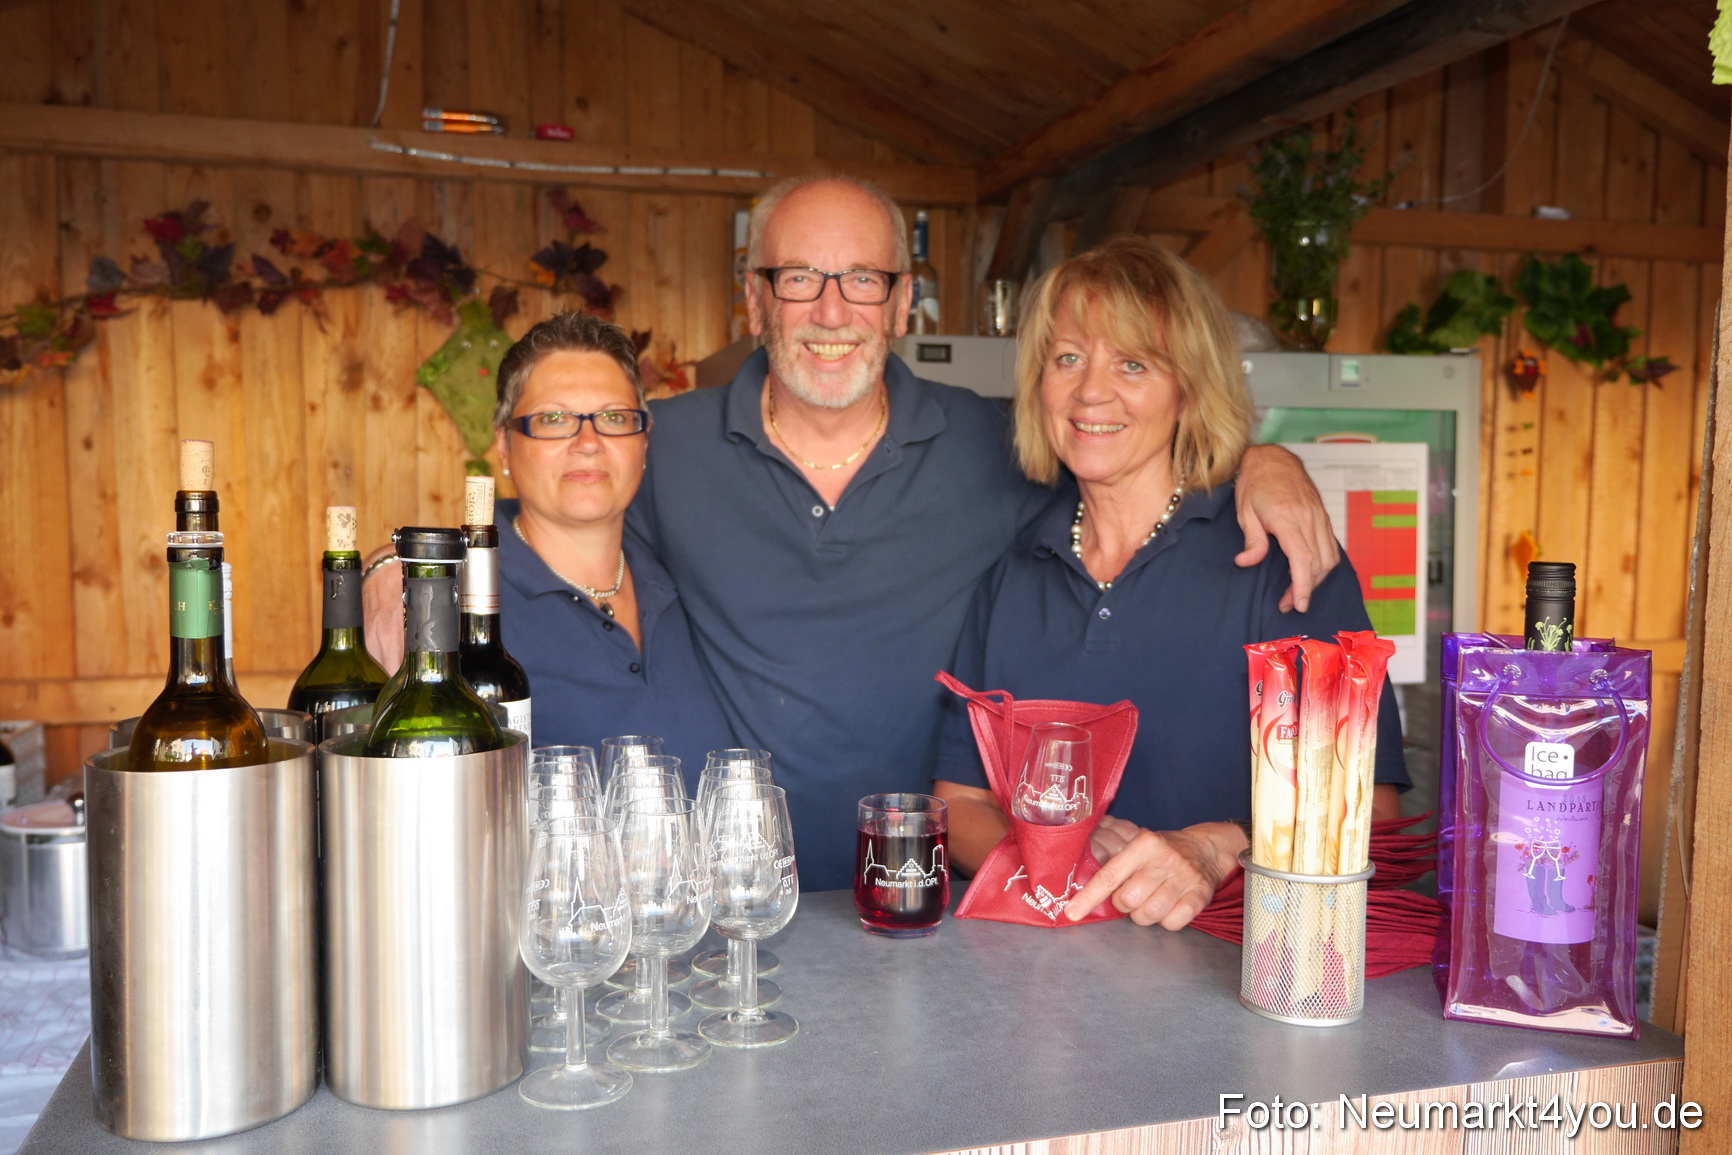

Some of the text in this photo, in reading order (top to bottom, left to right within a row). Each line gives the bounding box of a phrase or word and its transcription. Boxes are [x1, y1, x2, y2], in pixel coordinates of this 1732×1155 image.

[1531, 746, 1559, 763] Ice
[1562, 794, 1587, 803] 2015
[875, 877, 911, 888] Neumarkt
